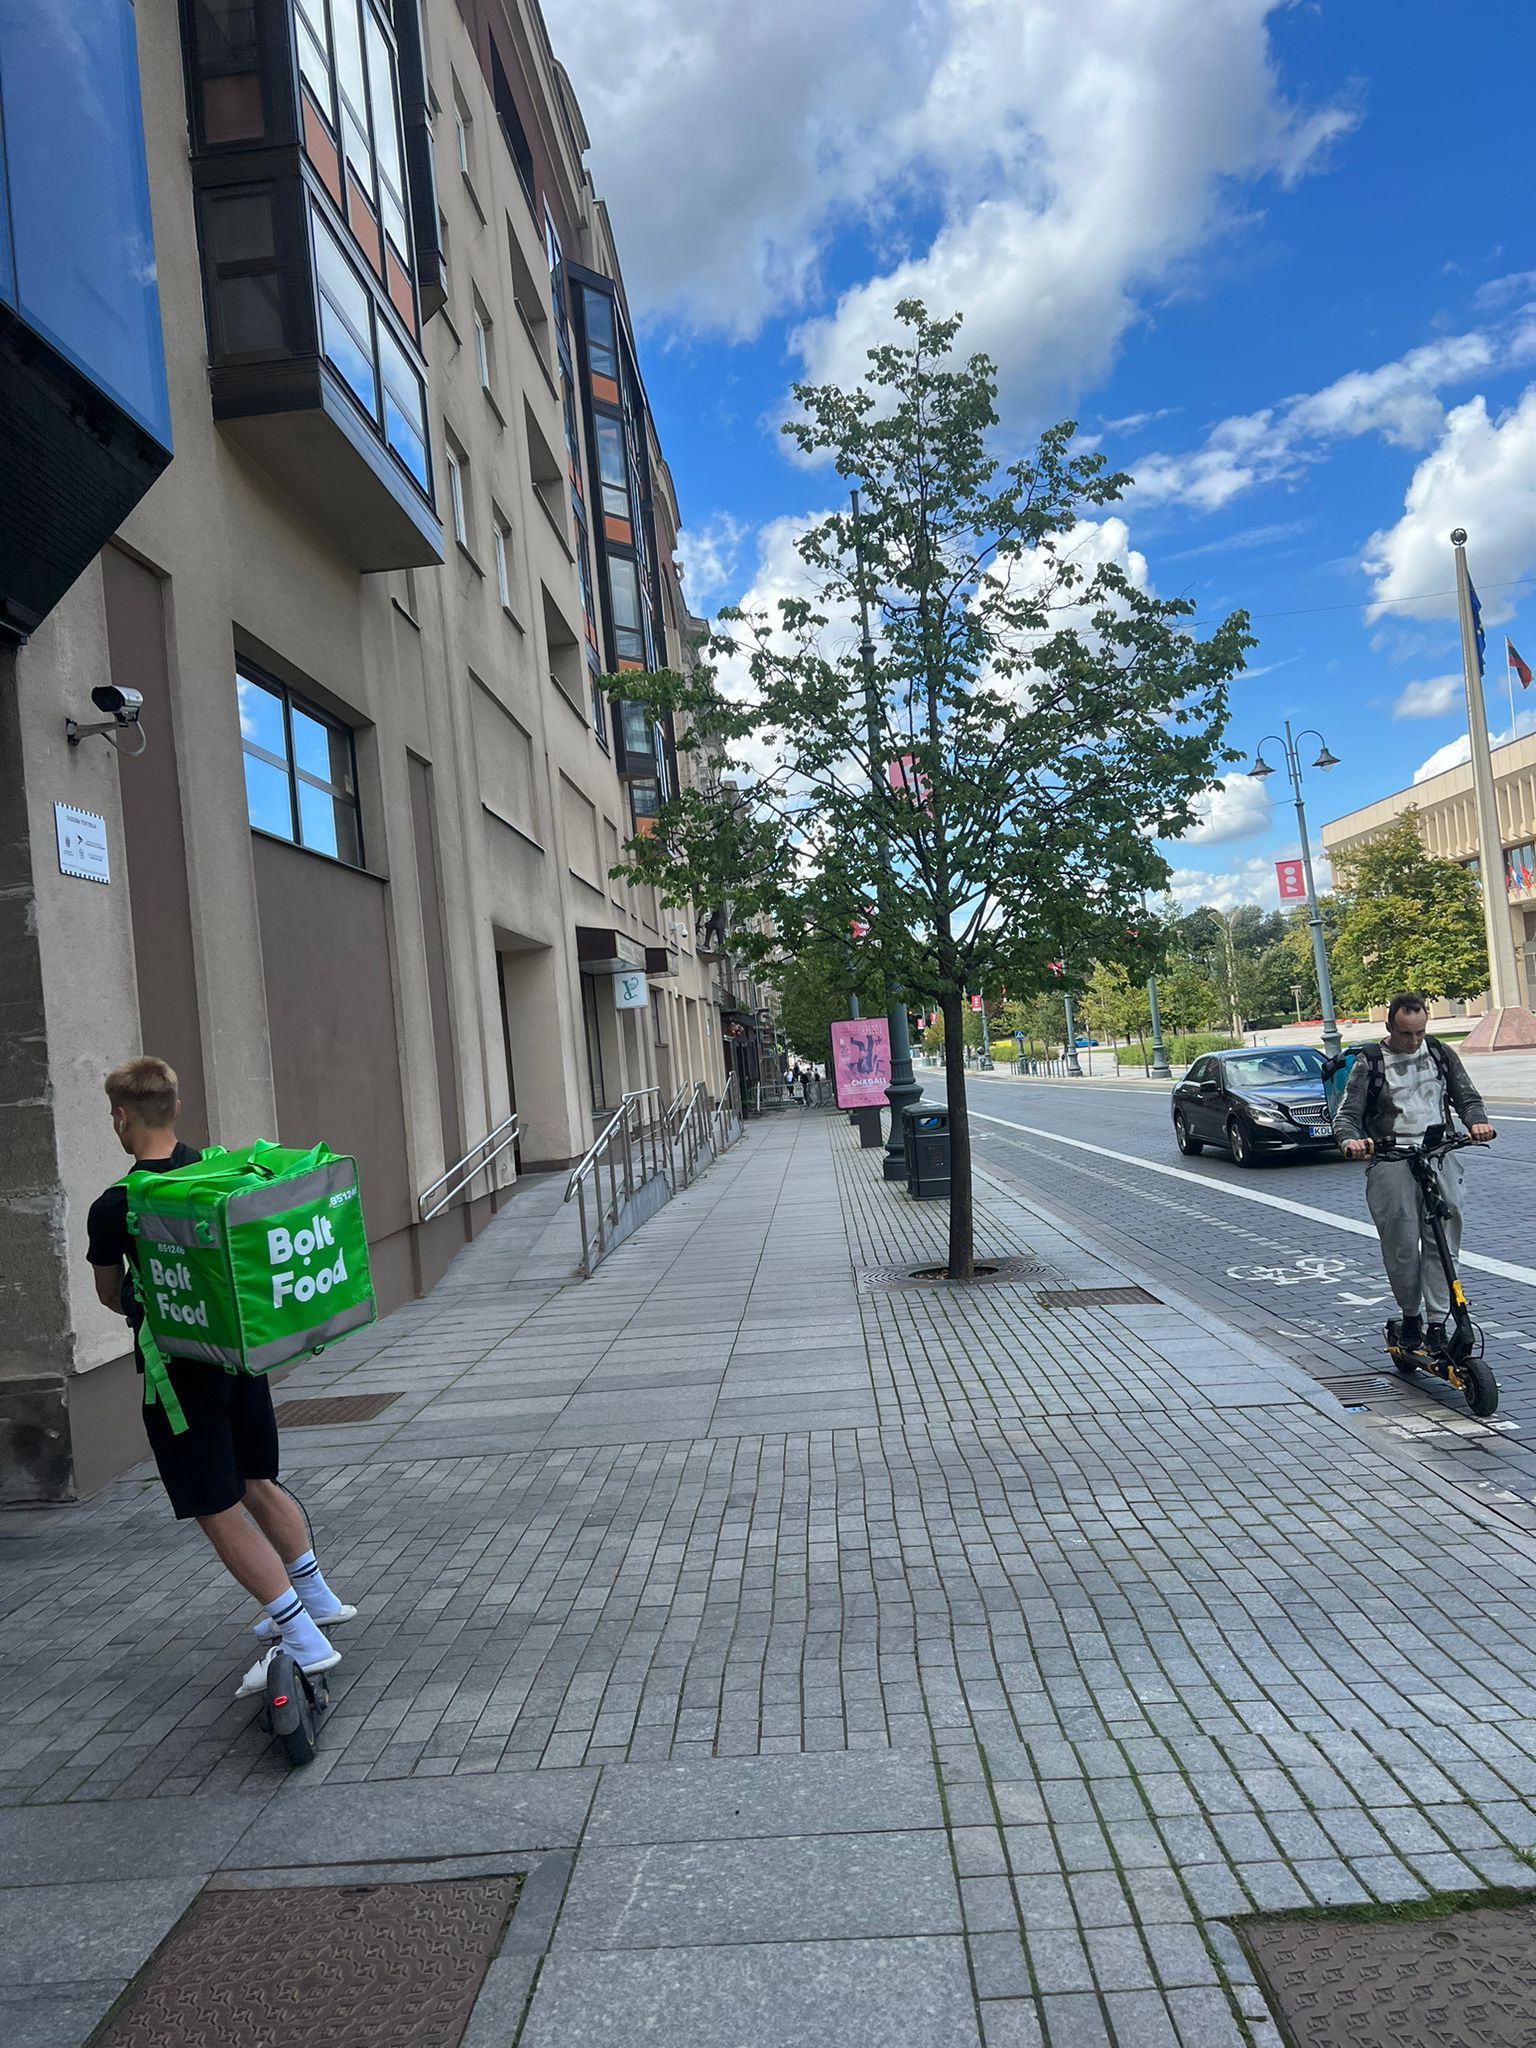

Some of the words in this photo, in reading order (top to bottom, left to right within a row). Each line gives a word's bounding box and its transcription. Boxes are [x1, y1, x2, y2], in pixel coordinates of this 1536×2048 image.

[851, 1077, 887, 1087] CHAGALL
[267, 1214, 335, 1265] Bolt
[149, 1258, 192, 1292] Bolt
[272, 1247, 348, 1309] Food
[156, 1292, 209, 1328] Food
